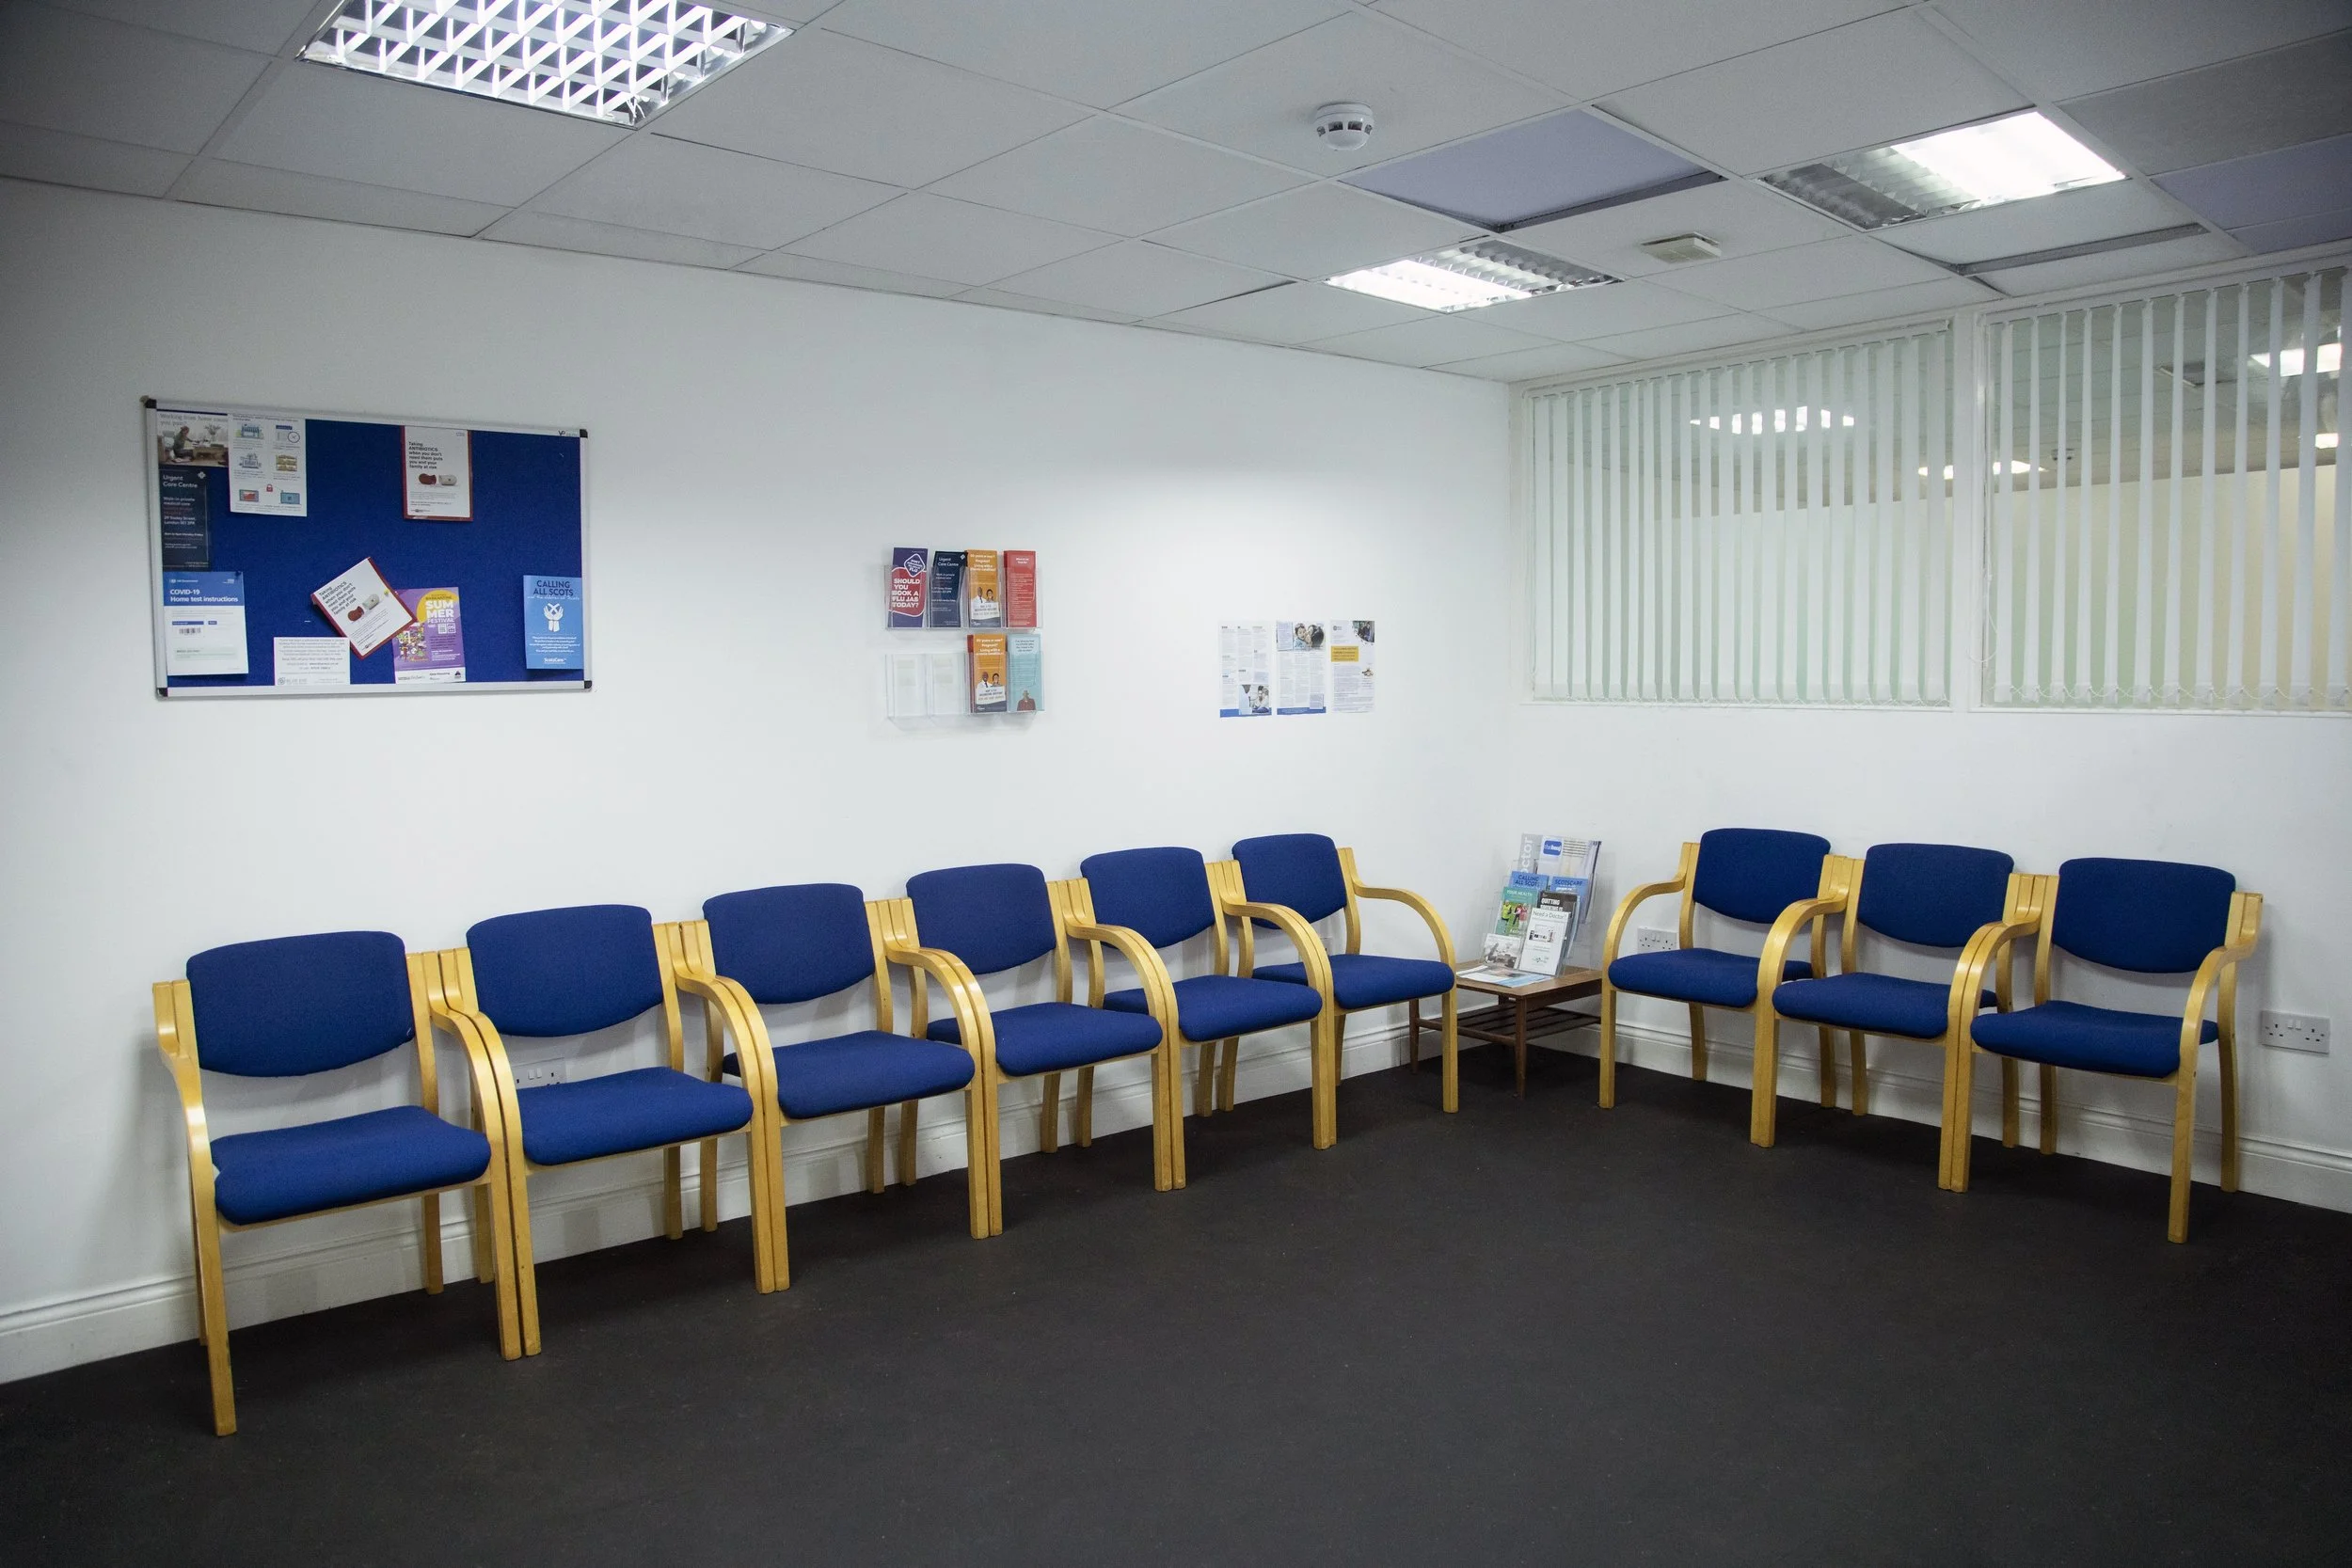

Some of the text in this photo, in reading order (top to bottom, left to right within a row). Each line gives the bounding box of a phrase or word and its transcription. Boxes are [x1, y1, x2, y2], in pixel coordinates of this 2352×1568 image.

[536, 579, 570, 589] CALLING
[319, 586, 333, 596] Taking
[322, 581, 347, 600] ANTIBIOTICS
[325, 595, 336, 604] when
[342, 582, 353, 592] don't
[548, 588, 574, 596] SCOTS
[327, 599, 339, 608] need
[338, 593, 348, 601] them
[425, 599, 454, 609] SUM
[333, 606, 346, 615] family
[426, 609, 454, 618] MER
